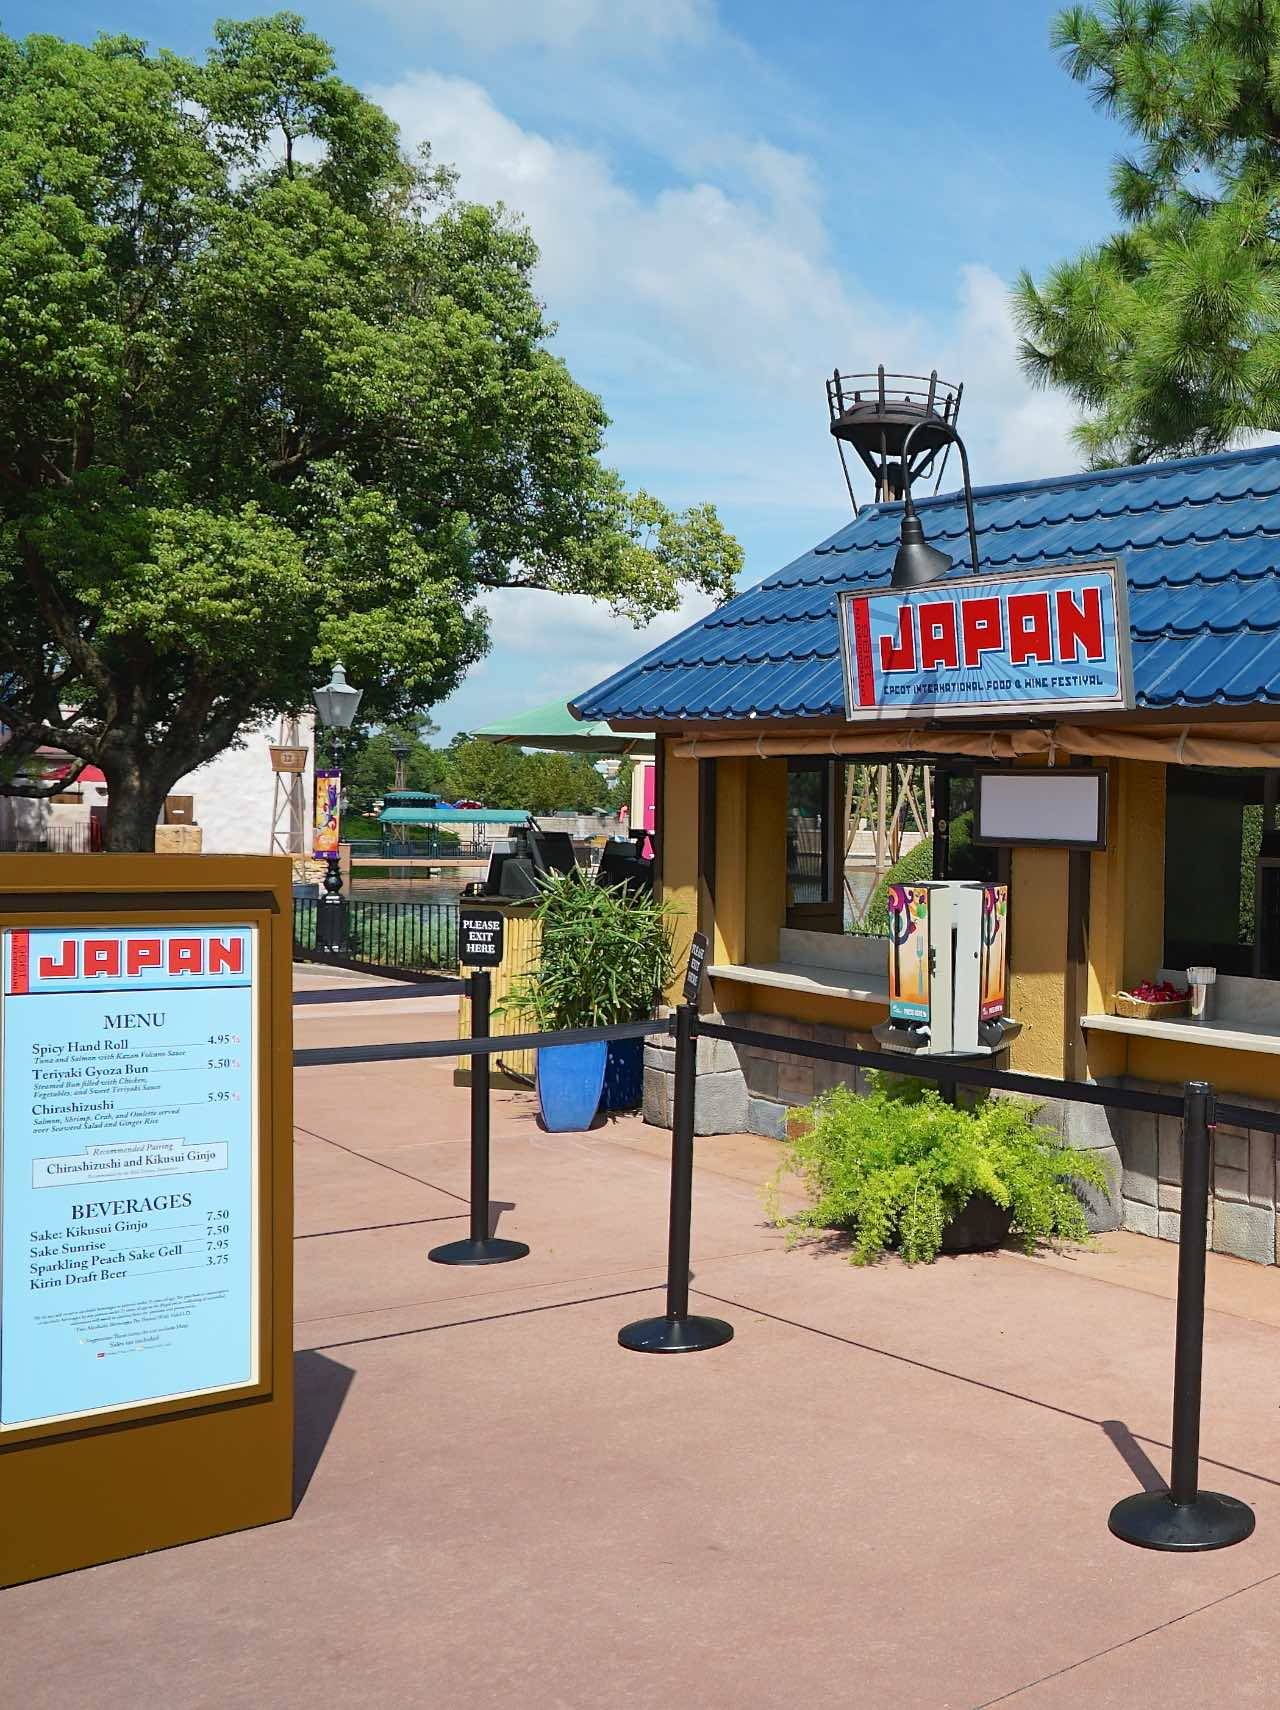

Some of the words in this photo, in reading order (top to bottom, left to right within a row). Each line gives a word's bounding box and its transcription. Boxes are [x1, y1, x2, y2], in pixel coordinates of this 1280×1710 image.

[879, 586, 1104, 672] JAPAN
[884, 685, 911, 694] EPCOT
[914, 682, 984, 694] INTERNATIONAL
[986, 680, 1011, 690] FOOD
[1024, 678, 1048, 688] WINE
[1050, 674, 1104, 687] FESTIVAL
[463, 920, 500, 930] PLEASE
[468, 932, 494, 942] EXIT
[466, 944, 496, 953] HERE
[39, 938, 244, 979] JAPAN
[104, 1013, 166, 1029] MENU
[208, 1035, 229, 1045] 4.95
[32, 1043, 64, 1057] Spicy
[68, 1041, 100, 1052] Hand
[104, 1040, 128, 1050] Roll
[208, 1059, 230, 1069] 5.50
[32, 1069, 82, 1083] Teriyaki
[86, 1066, 122, 1080] Gyoza
[126, 1064, 148, 1074] Bun
[208, 1092, 229, 1102] 5.95
[32, 1100, 114, 1115] Chirashizushi
[47, 1159, 121, 1175] Chirashizushi
[124, 1156, 142, 1168] and
[145, 1154, 184, 1166] Kikusui
[187, 1151, 216, 1161] Ginjo
[71, 1193, 192, 1220] BEVERAGES
[207, 1210, 229, 1221] 7.50
[30, 1229, 62, 1242] Sake:
[66, 1224, 111, 1239] Kikusui
[115, 1220, 148, 1233] Ginjo
[207, 1225, 229, 1236] 7.50
[30, 1245, 59, 1258] Sake
[62, 1241, 106, 1255] Sunrise
[207, 1240, 229, 1251] 7.95
[31, 1259, 89, 1276] Sparkling
[92, 1252, 125, 1266] Peach
[129, 1249, 154, 1261] Sake
[159, 1245, 182, 1258] Gell
[206, 1254, 229, 1266] 3.75
[30, 1277, 61, 1290] Kirin
[65, 1274, 97, 1285] Draft
[101, 1270, 127, 1282] Beer
